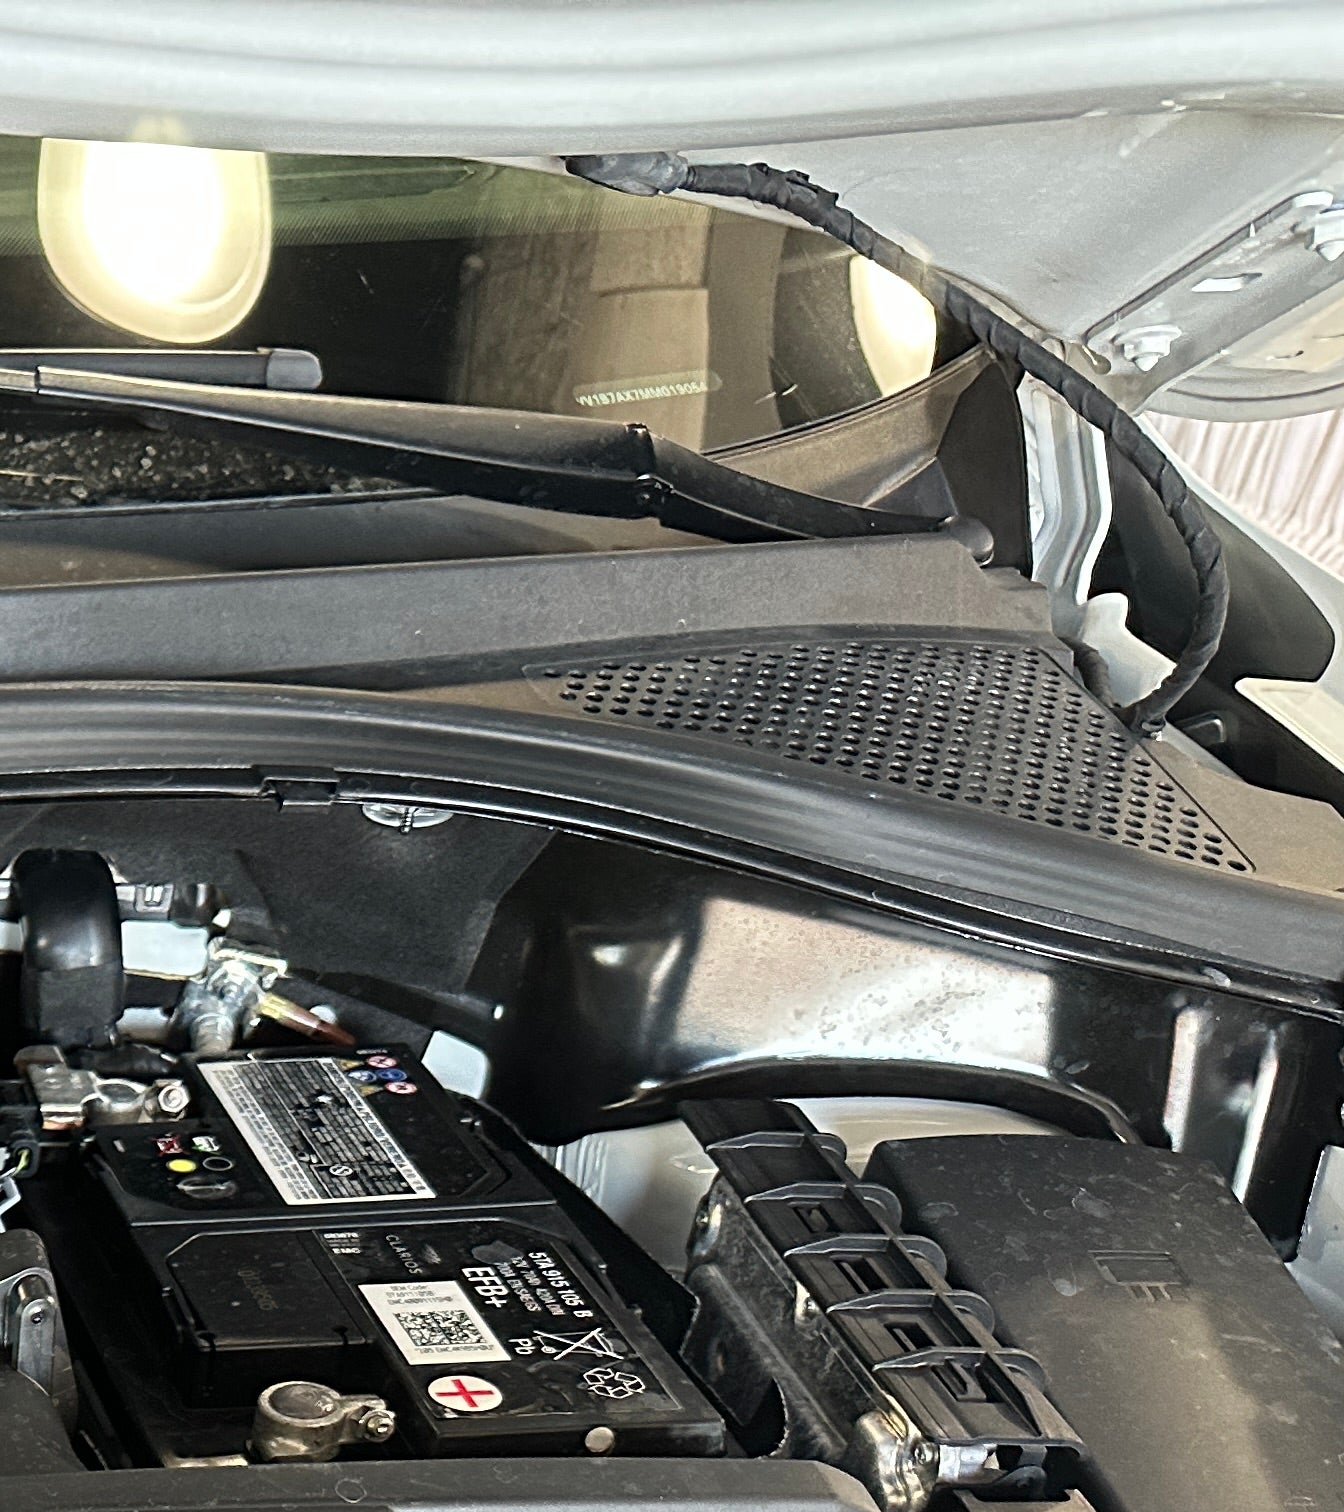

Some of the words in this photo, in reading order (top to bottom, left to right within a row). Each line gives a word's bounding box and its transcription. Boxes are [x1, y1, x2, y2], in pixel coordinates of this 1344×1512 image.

[386, 1234, 423, 1274] CLARIOS
[462, 1267, 510, 1308] EFB+
[528, 1252, 555, 1269] 5TA
[542, 1270, 570, 1287] 915
[557, 1289, 585, 1306] 105
[508, 1338, 536, 1355] Pb
